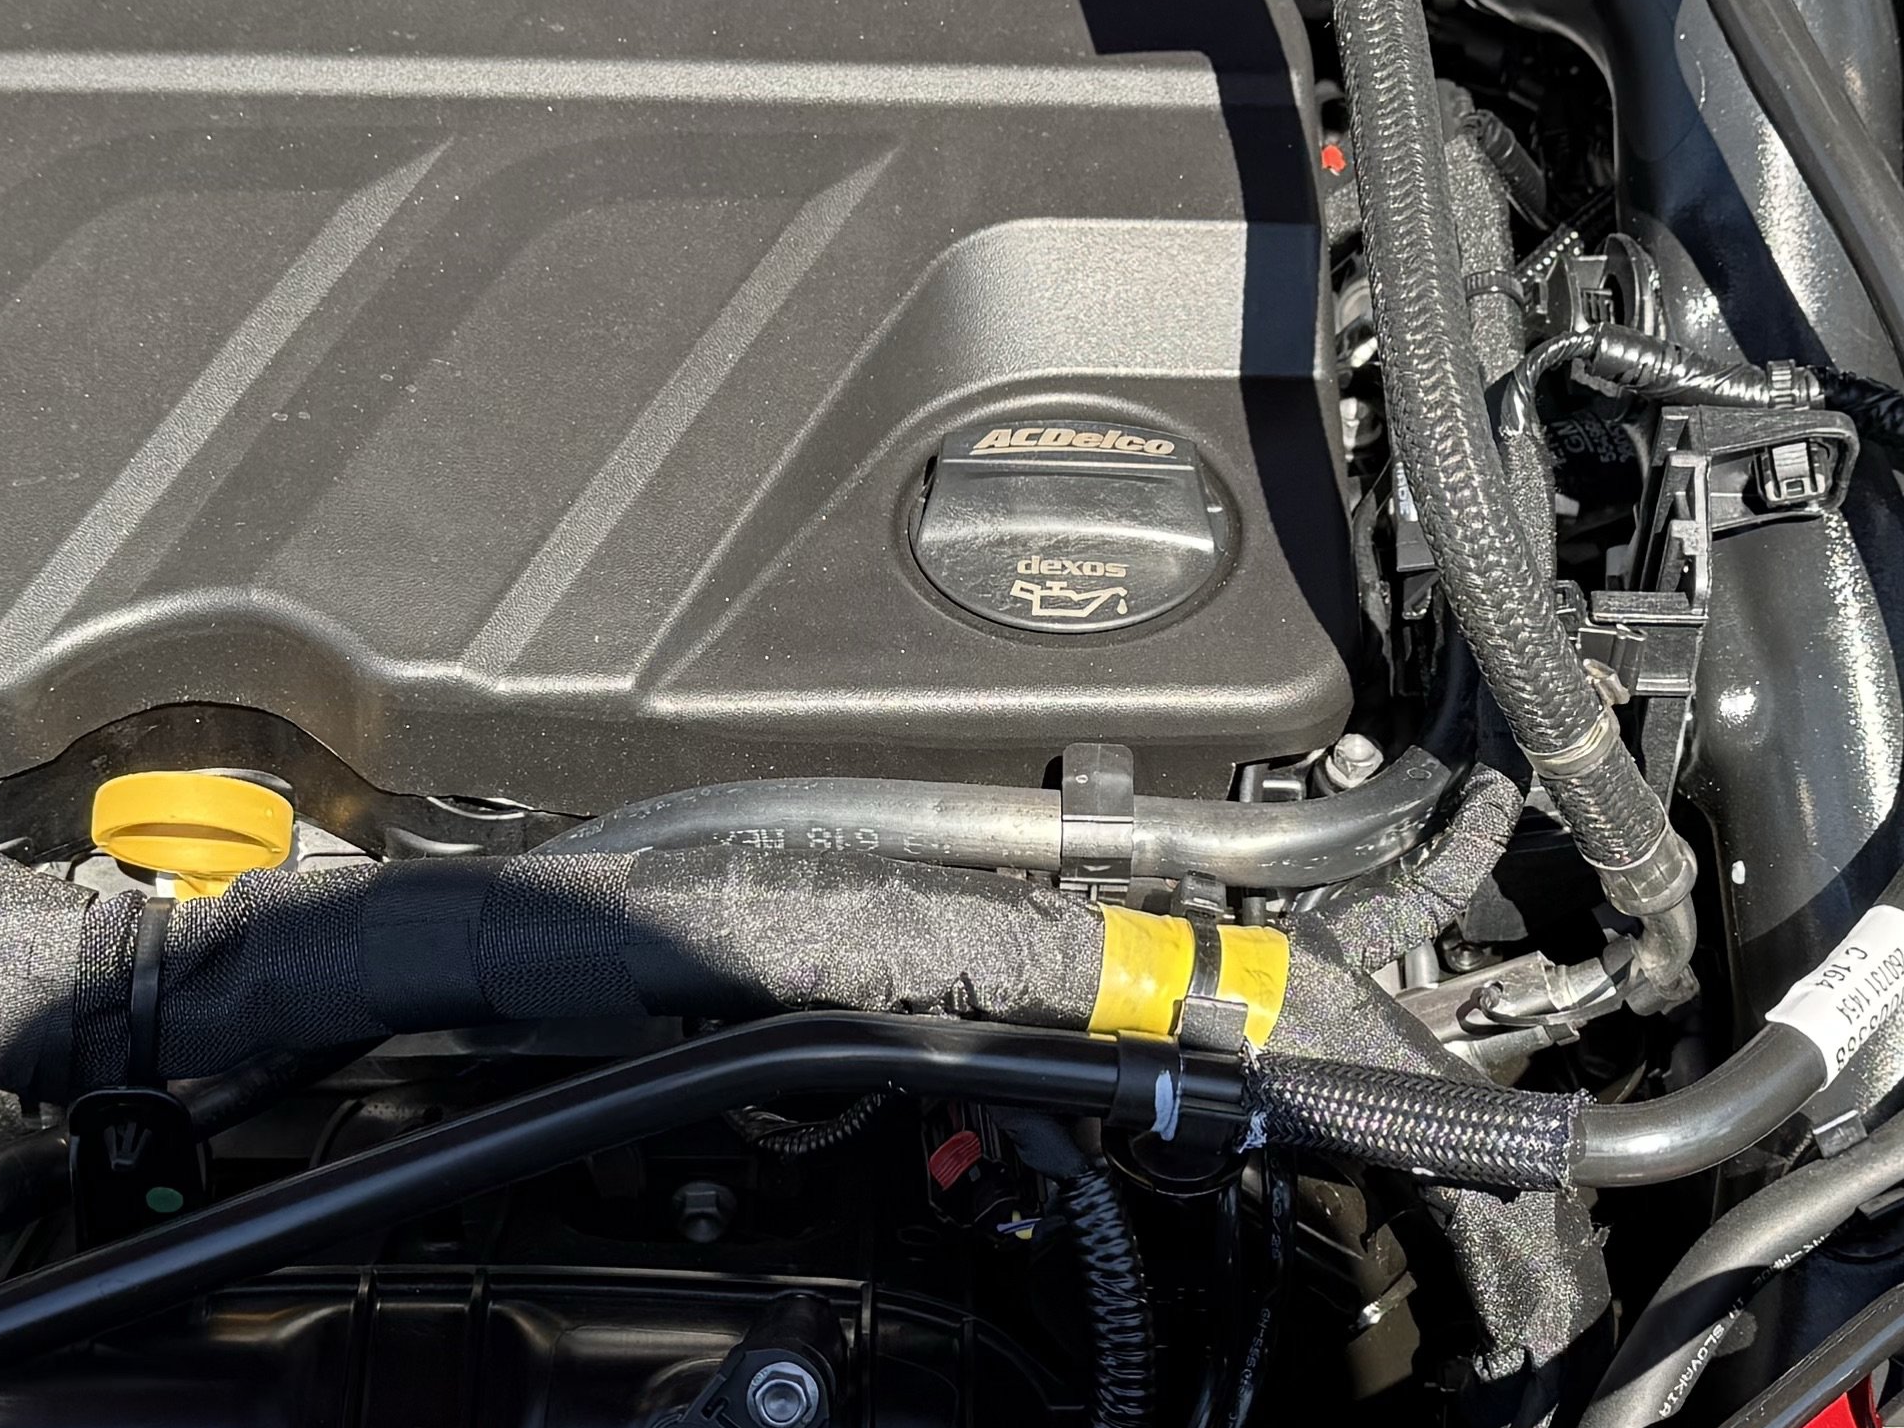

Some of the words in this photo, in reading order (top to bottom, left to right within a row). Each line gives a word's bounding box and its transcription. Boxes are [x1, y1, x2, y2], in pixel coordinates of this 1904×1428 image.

[972, 427, 1175, 456] ACDelco
[1016, 556, 1129, 578] dexos
[1658, 1323, 1727, 1419] SLOVAKIA
